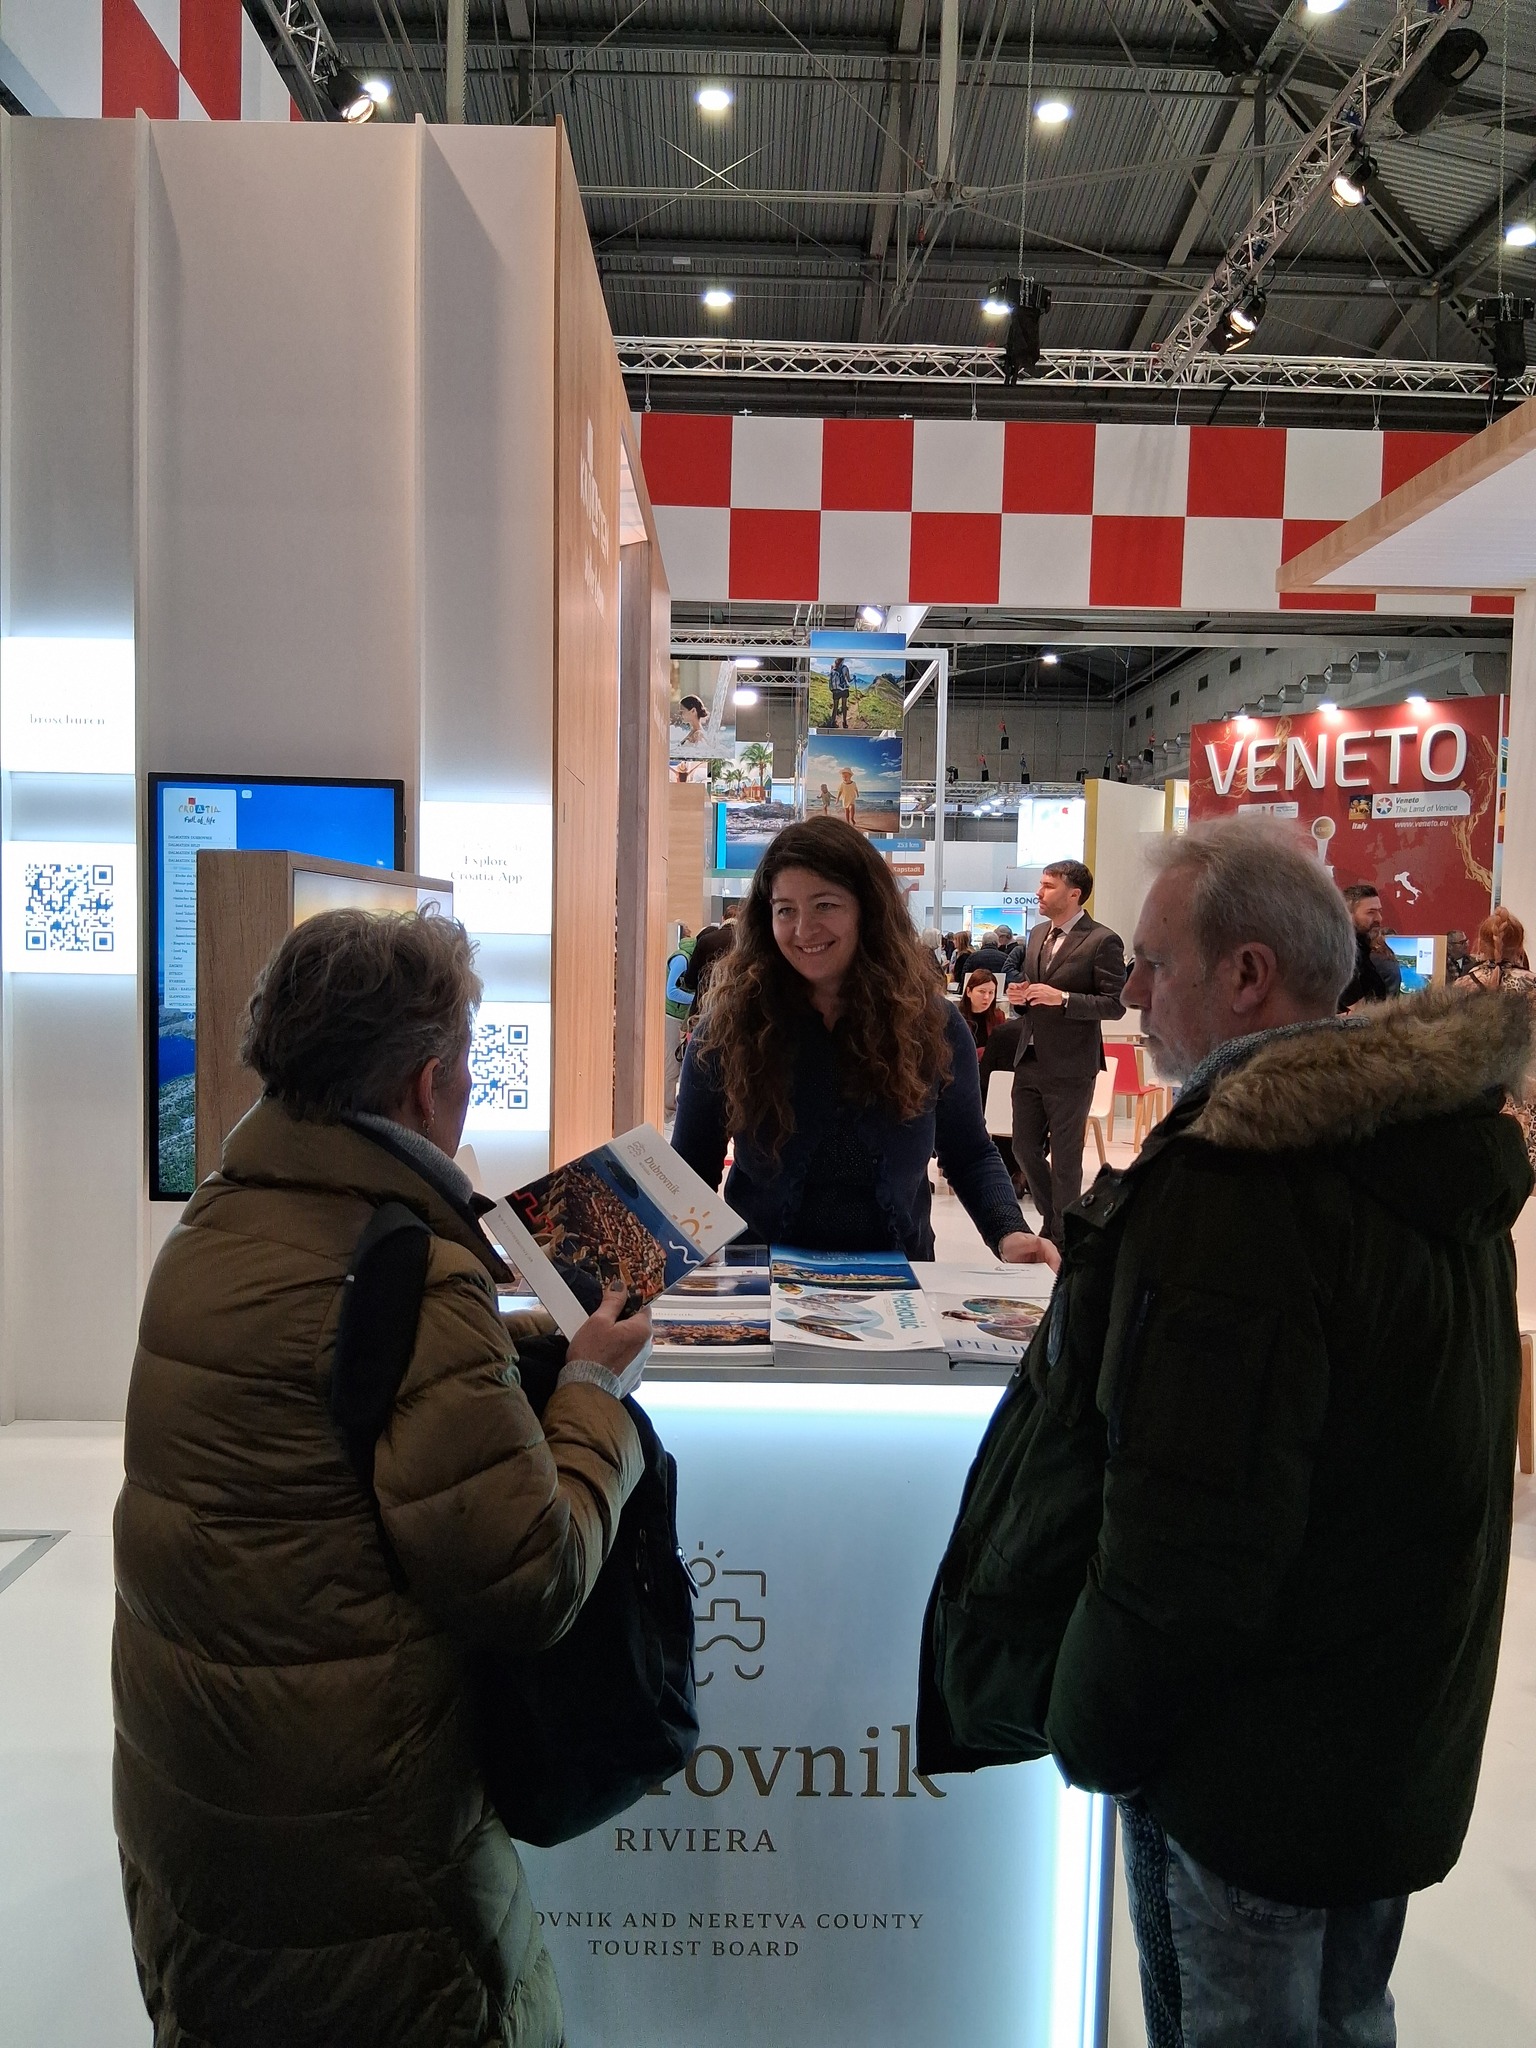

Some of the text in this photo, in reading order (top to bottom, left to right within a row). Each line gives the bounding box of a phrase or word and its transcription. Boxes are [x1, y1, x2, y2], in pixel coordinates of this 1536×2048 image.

[1204, 722, 1468, 797] VENETO
[1395, 796, 1420, 804] Veneto
[178, 804, 221, 814] CROATIA
[1395, 803, 1458, 814] The Land of Venice
[1351, 822, 1369, 831] Italy
[498, 872, 523, 885] App
[1003, 897, 1013, 905] IO
[643, 1156, 680, 1196] Dubrovnik
[645, 1724, 947, 1798] ovnik
[614, 1827, 778, 1853] RIVIERA
[622, 1912, 677, 1928] AND
[688, 1912, 807, 1929] NERETVA
[817, 1912, 924, 1930] COUNTY
[588, 1940, 800, 1957] TOURIST BOARD
